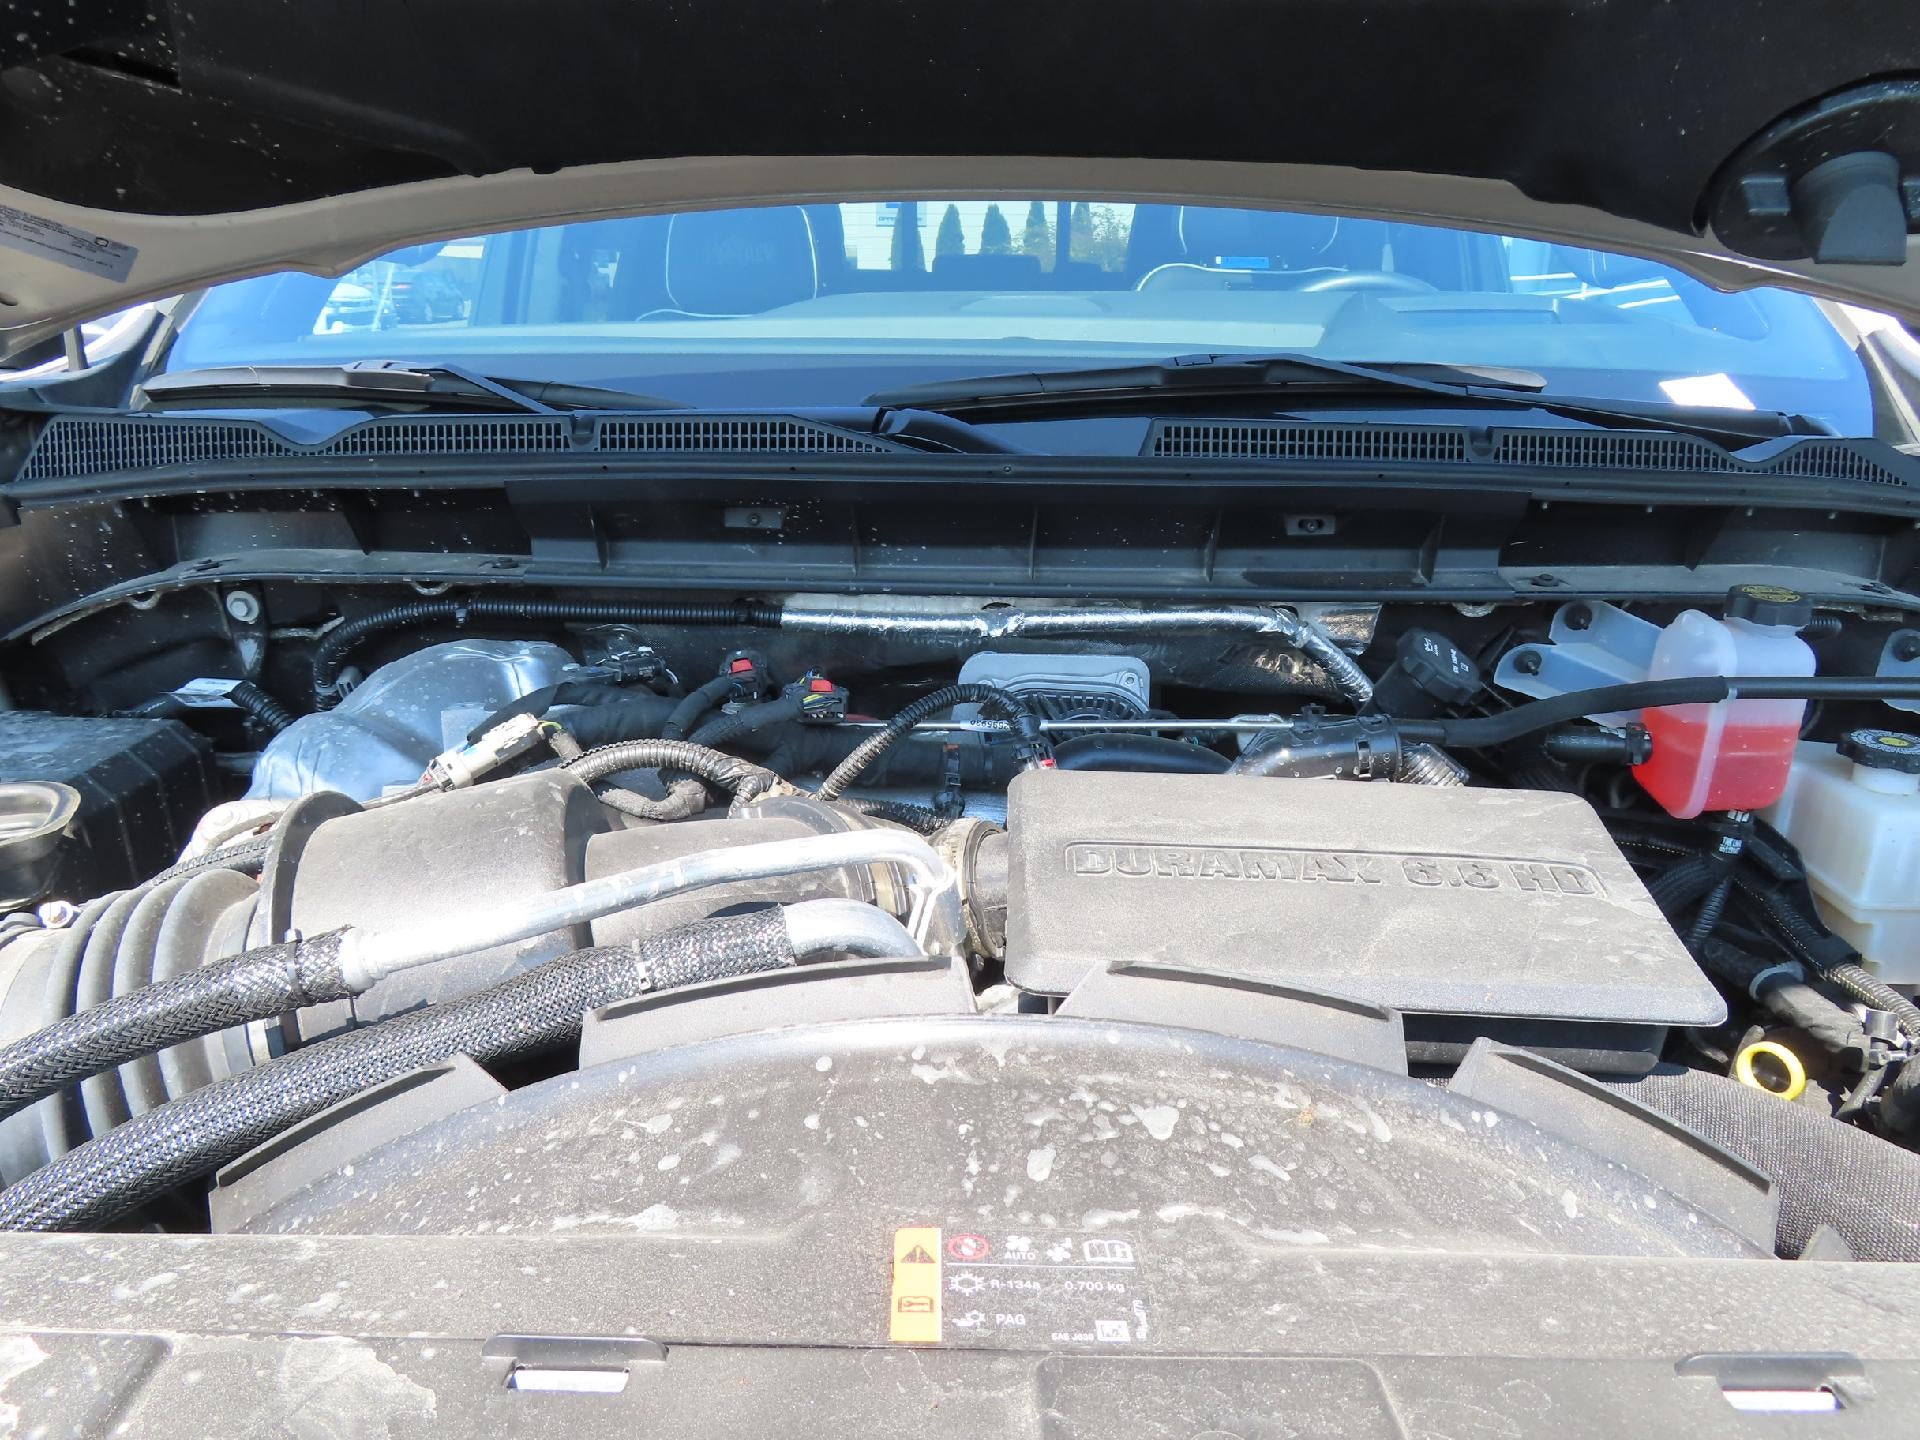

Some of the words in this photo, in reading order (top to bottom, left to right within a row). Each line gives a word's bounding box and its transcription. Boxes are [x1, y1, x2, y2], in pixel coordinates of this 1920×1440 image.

[1073, 848, 1381, 884] DURAMAX
[1401, 856, 1500, 889] 6.6
[1508, 863, 1596, 896] HD
[1004, 1251, 1036, 1260] AUTO
[990, 1279, 1041, 1290] R-134a
[1064, 1280, 1104, 1292] 0.700
[1106, 1281, 1125, 1293] kg
[995, 1313, 1026, 1325] PAG
